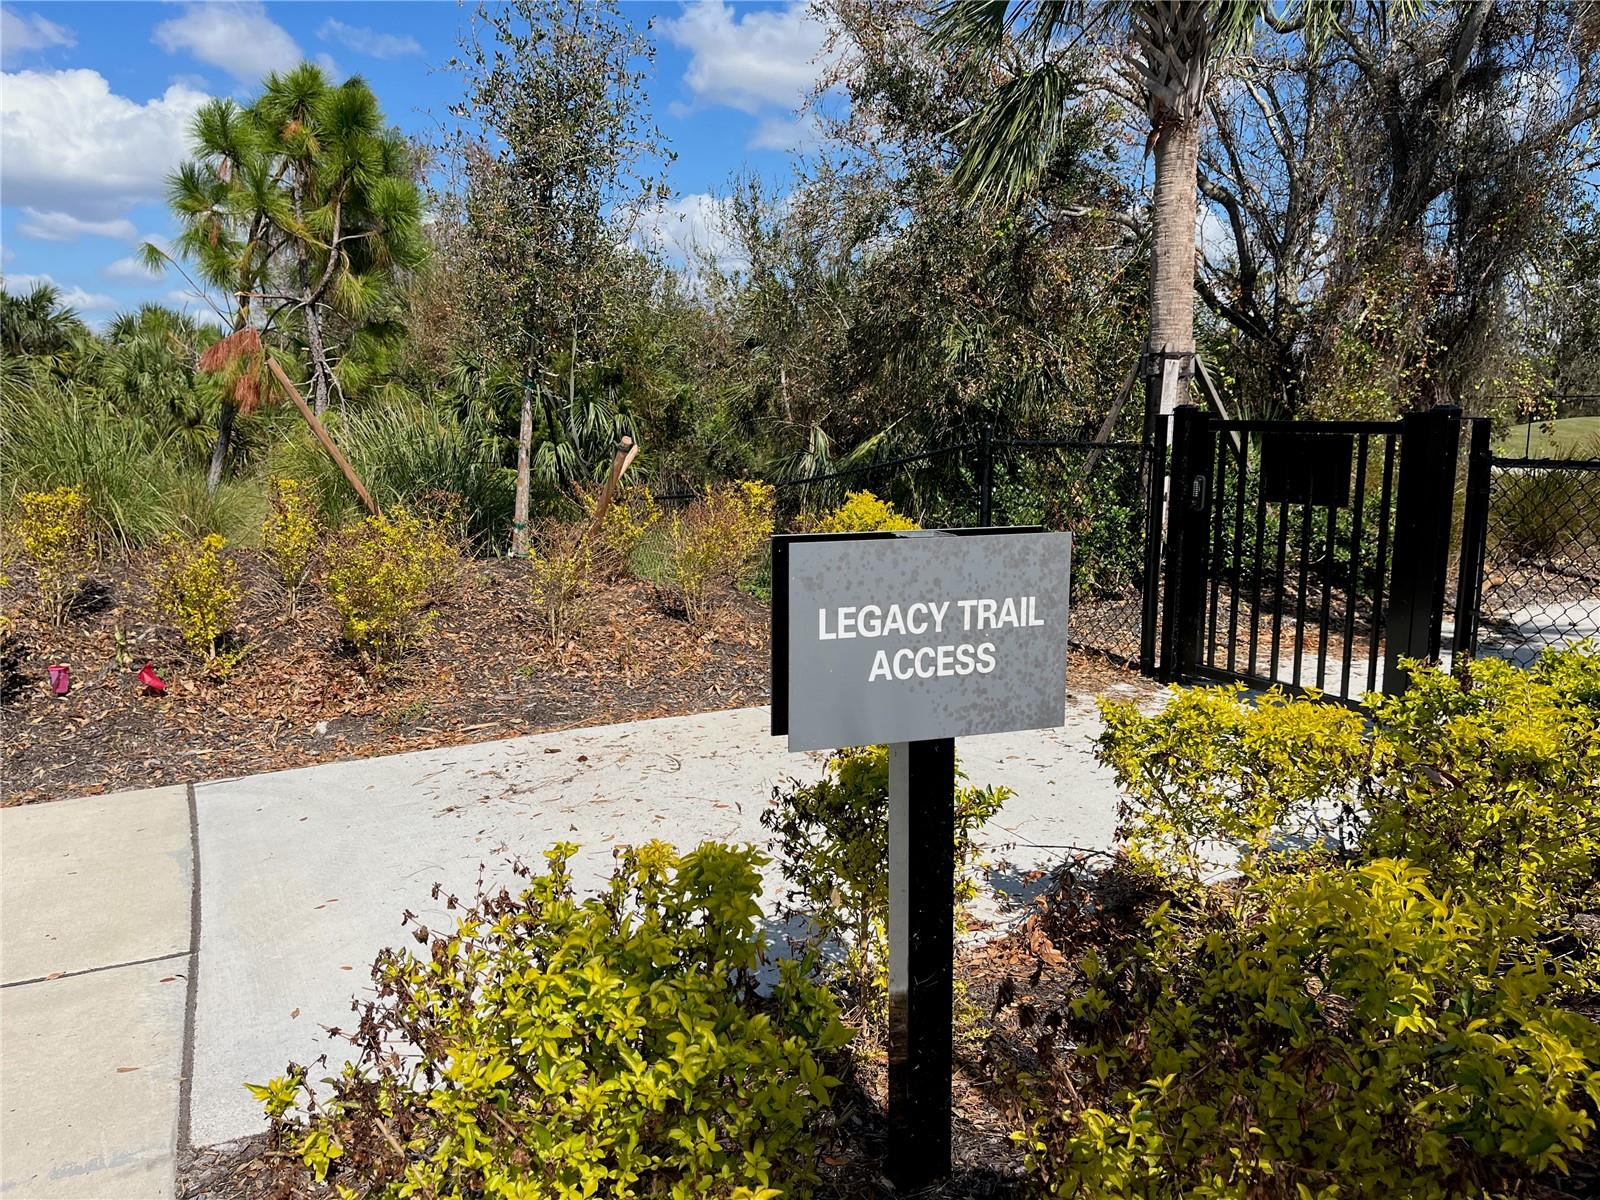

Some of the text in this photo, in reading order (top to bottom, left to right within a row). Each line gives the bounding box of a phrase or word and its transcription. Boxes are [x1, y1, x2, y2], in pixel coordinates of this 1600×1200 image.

[818, 597, 1045, 641] LEGACY TRAIL
[868, 643, 996, 682] ACCESS
